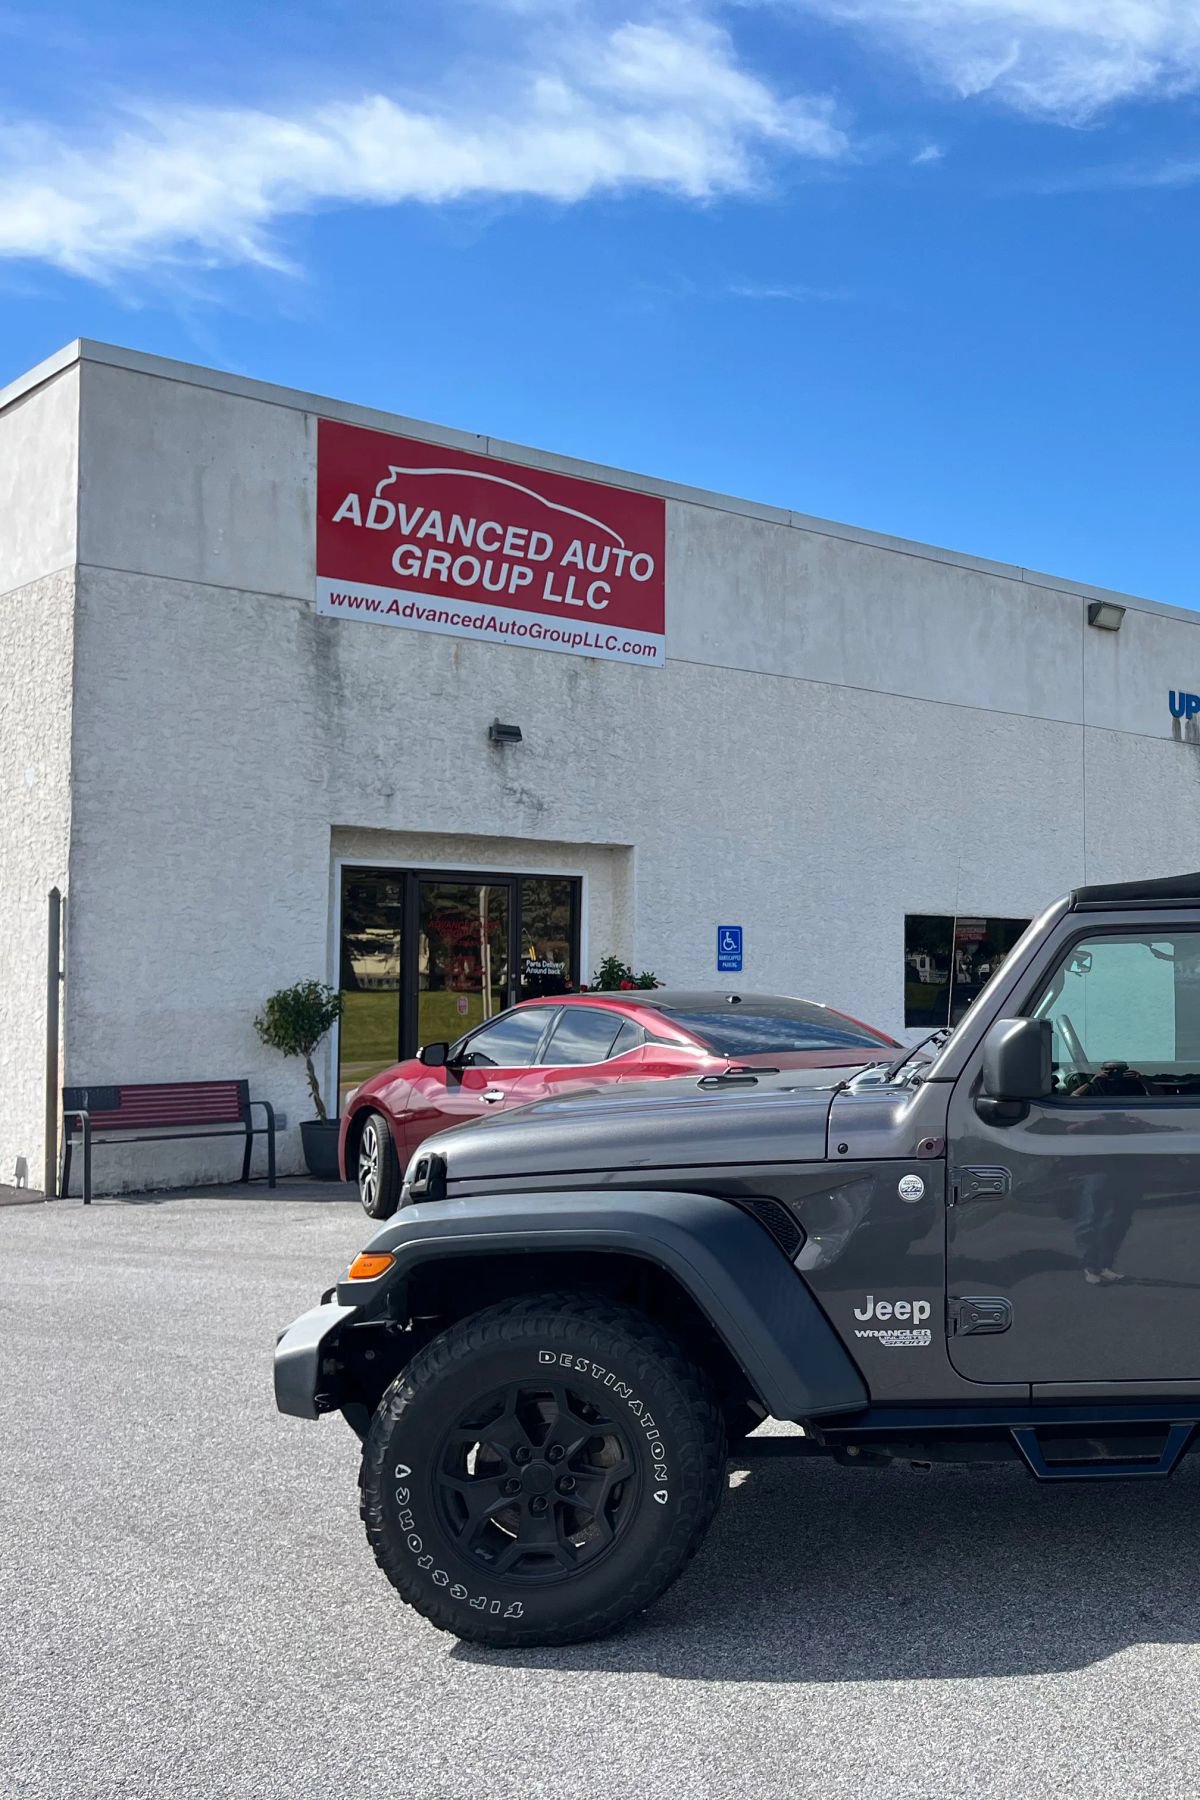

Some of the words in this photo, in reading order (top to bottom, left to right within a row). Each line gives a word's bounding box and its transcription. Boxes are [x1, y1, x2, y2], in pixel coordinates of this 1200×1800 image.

[332, 493, 553, 562] ADVANCED
[560, 539, 655, 582] AUTO
[391, 543, 533, 594] GROUP
[542, 571, 612, 610] LLC
[329, 591, 657, 658] www.AdvancedAutoGroupLLC.com
[526, 959, 541, 967] Parts
[542, 960, 565, 970] Delivery
[526, 967, 547, 975] Around
[854, 1296, 931, 1324] Jeep
[854, 1329, 931, 1338] WRANGLER
[539, 1350, 669, 1482] DESTINATION
